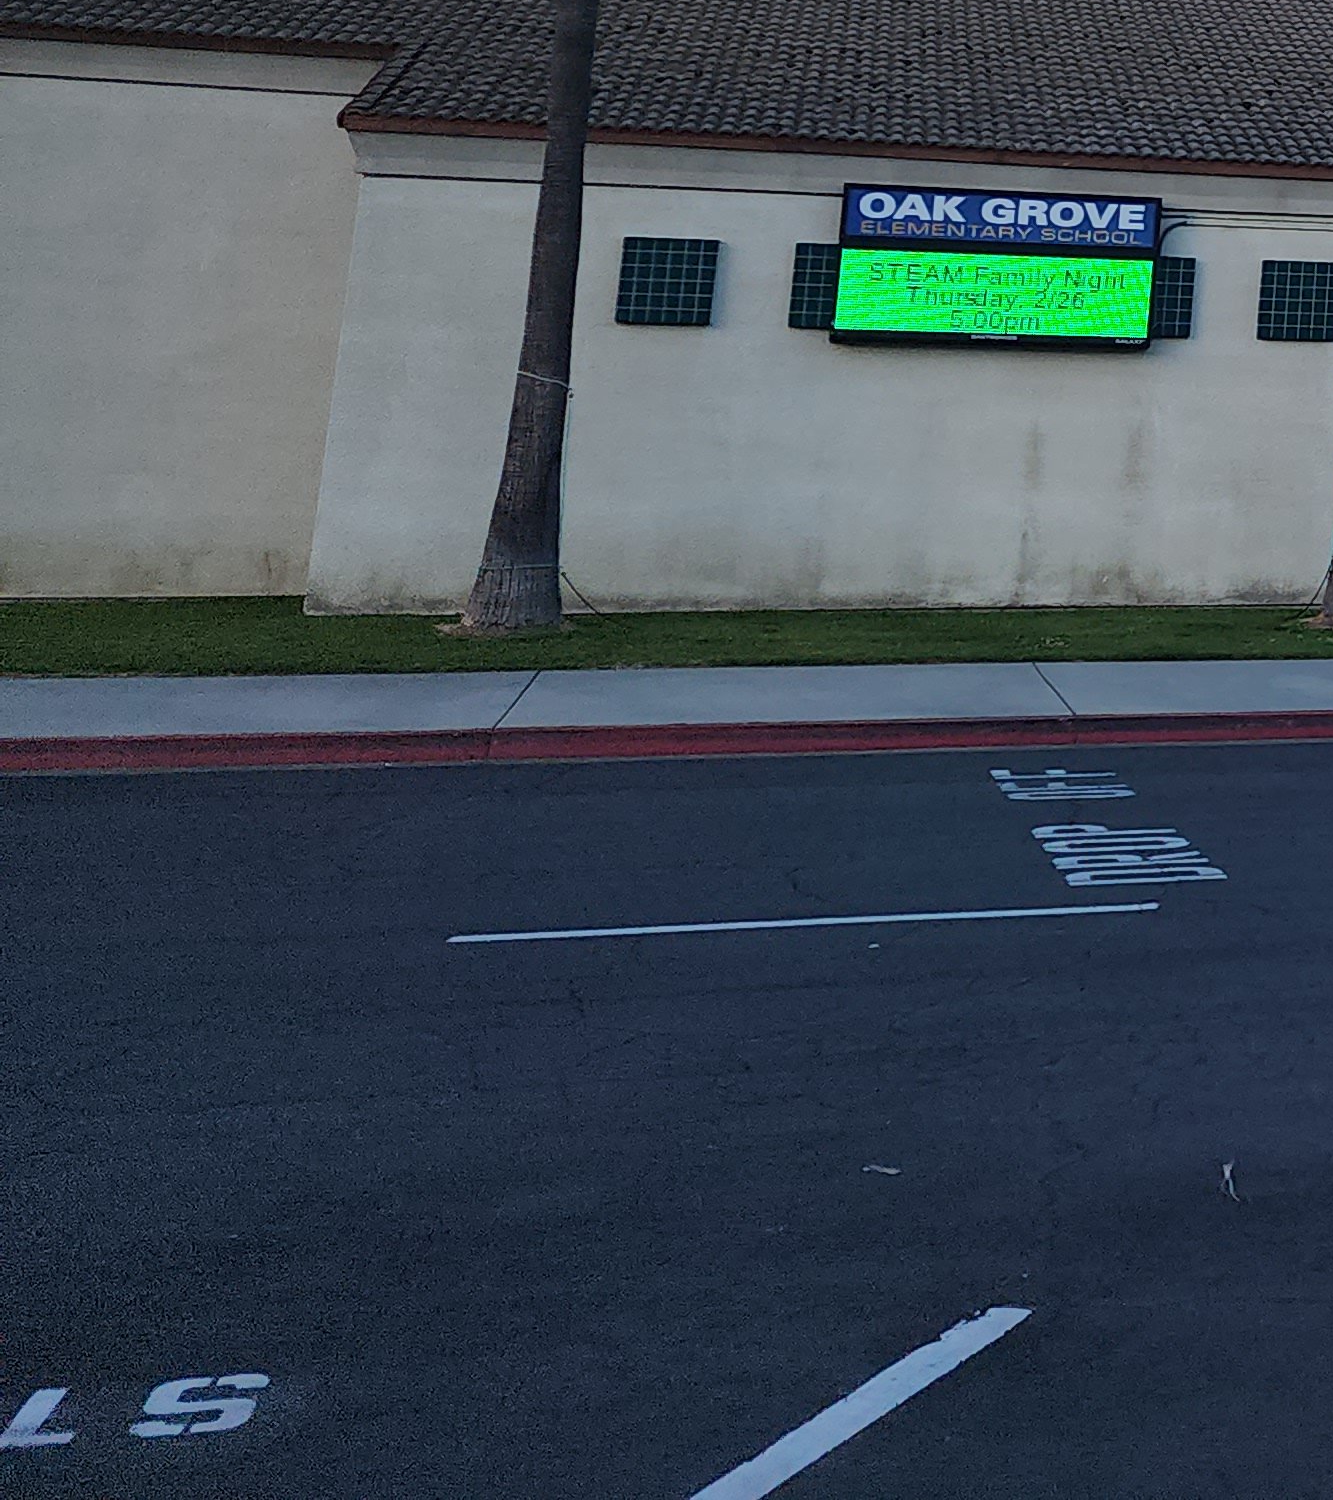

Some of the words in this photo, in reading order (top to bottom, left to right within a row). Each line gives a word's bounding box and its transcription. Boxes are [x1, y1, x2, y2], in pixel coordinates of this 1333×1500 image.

[859, 192, 967, 223] OAK
[981, 197, 1146, 230] GROVE
[860, 221, 1034, 240] ELEMENTARY
[1040, 228, 1142, 244] SCHOOL
[869, 262, 964, 285] STEAM
[975, 266, 1055, 291] Family
[1064, 269, 1126, 293] Night
[1034, 290, 1086, 309] 2/26
[990, 769, 1136, 800] OFF
[1031, 824, 1228, 887] DROP
